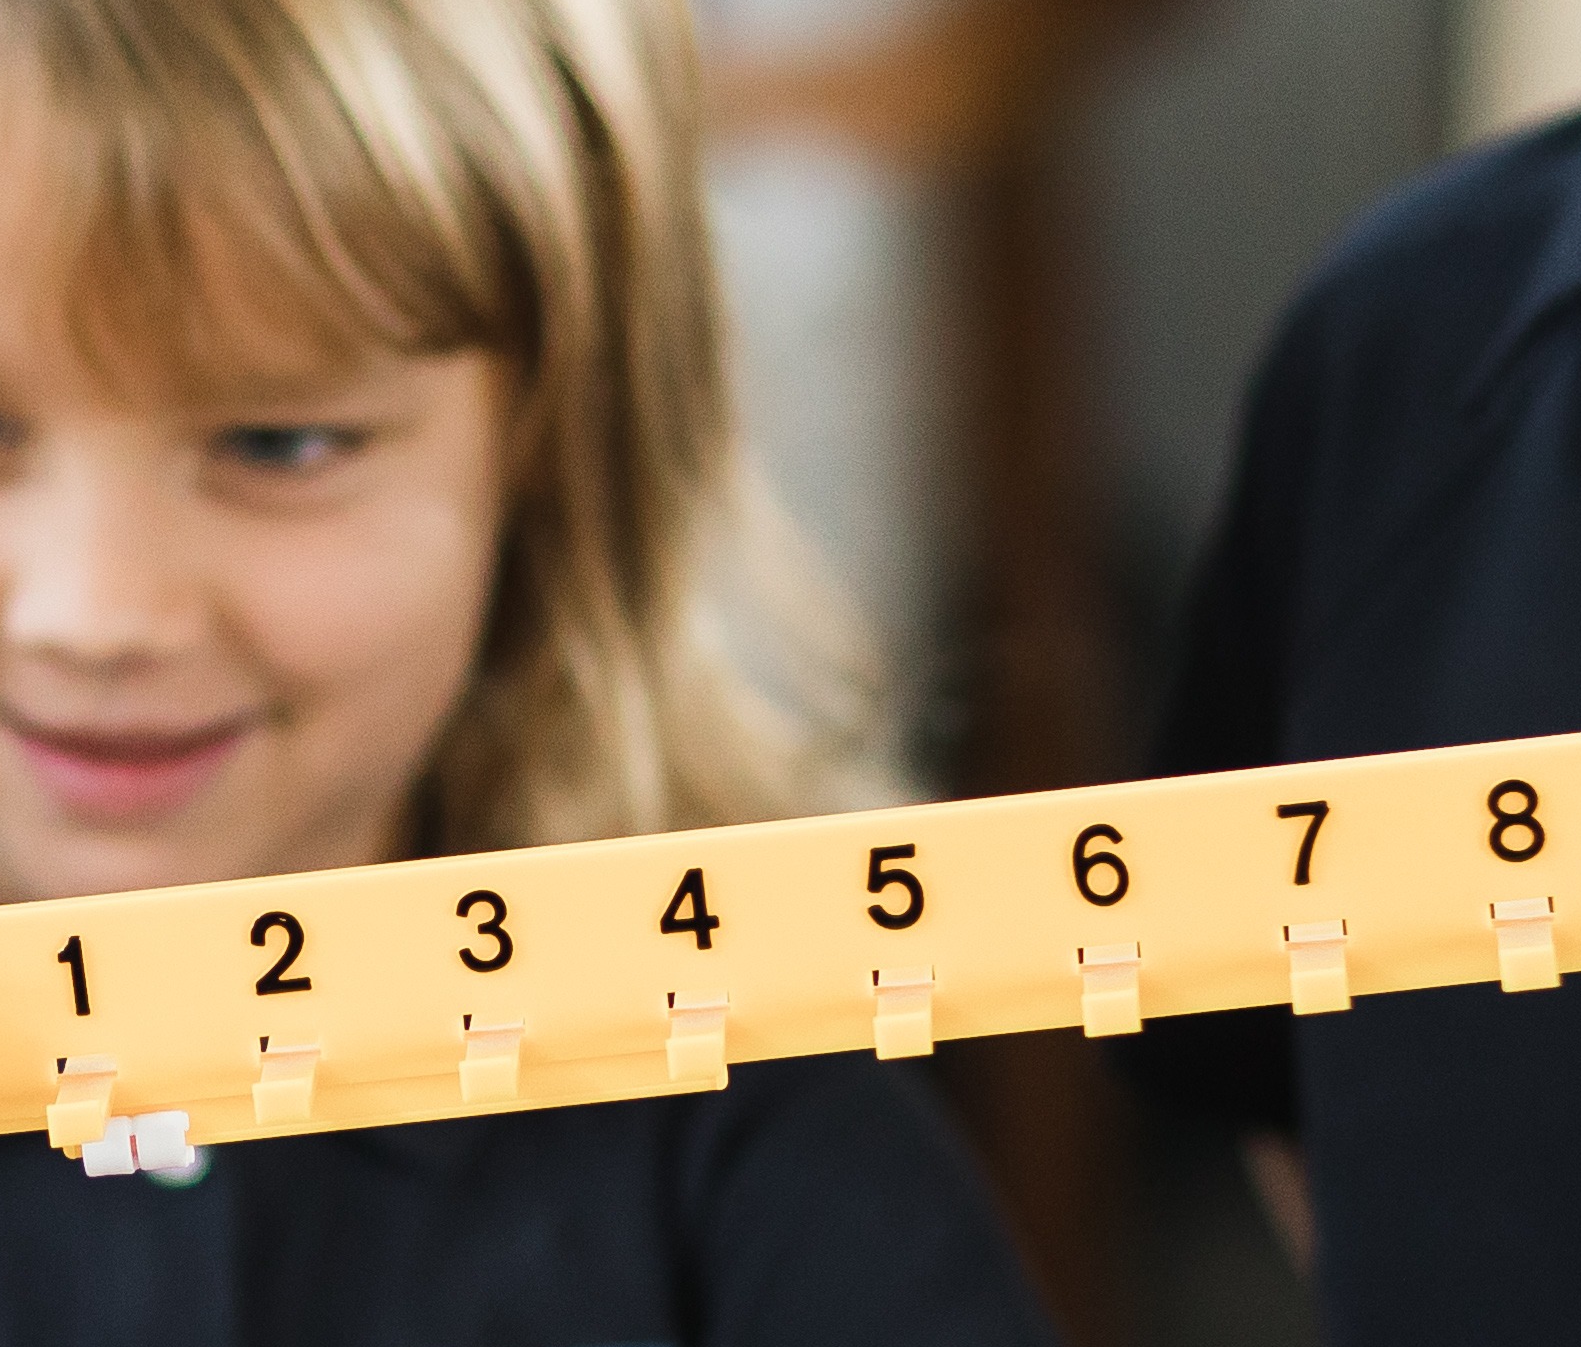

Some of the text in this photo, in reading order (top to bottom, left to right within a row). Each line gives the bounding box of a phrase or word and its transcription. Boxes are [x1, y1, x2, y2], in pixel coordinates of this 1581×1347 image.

[56, 934, 92, 1018] 1
[249, 910, 313, 997] 2
[454, 888, 515, 974] 3
[658, 866, 721, 952] 4
[865, 842, 926, 932] 5
[1071, 822, 1131, 908] 6
[1275, 799, 1331, 887] 7
[1486, 778, 1547, 864] 8
